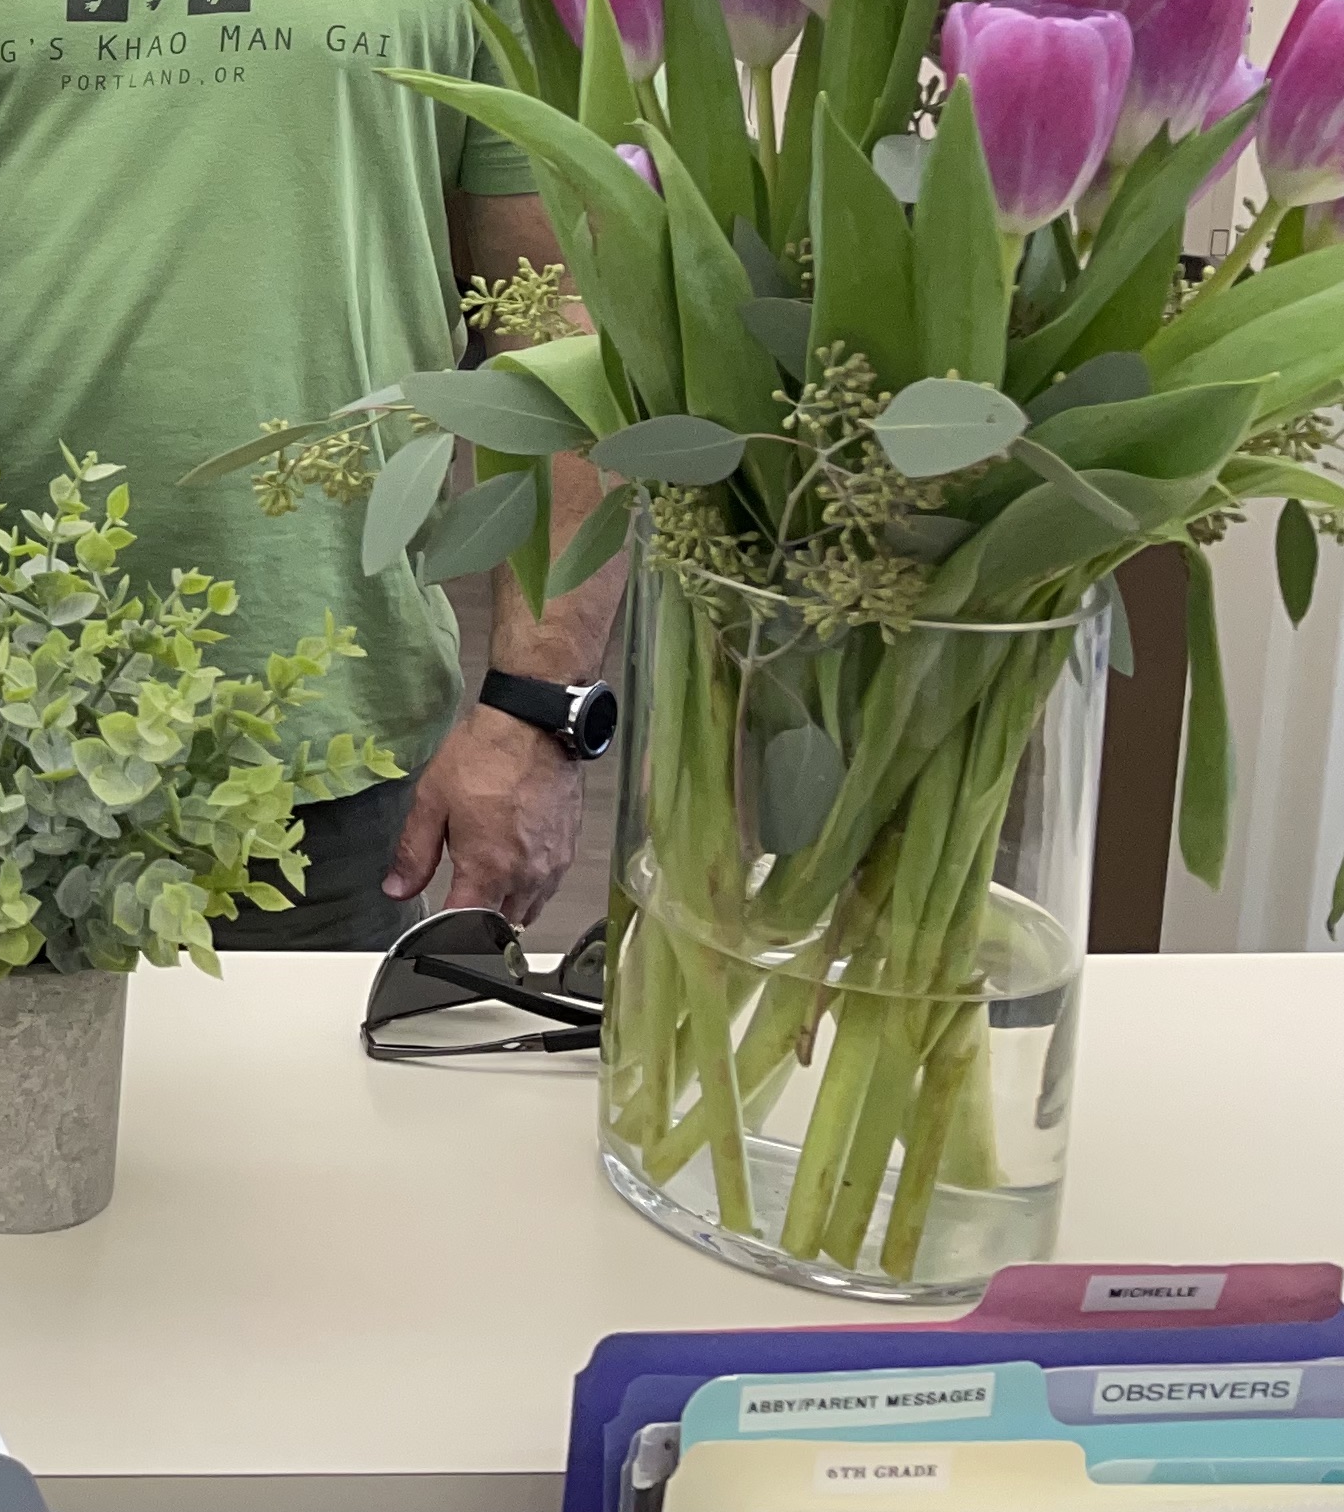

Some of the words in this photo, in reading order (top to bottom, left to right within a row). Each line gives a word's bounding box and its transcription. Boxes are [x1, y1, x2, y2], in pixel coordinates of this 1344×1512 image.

[98, 31, 187, 62] KHAO
[219, 24, 293, 53] MAN
[326, 23, 393, 58] GAI
[1109, 1287, 1199, 1298] MICHELLE
[886, 1387, 987, 1410] MESSAGES
[1100, 1380, 1291, 1404] OBSERVERS
[826, 1464, 868, 1480] 6TH
[873, 1463, 939, 1480] GRADE
